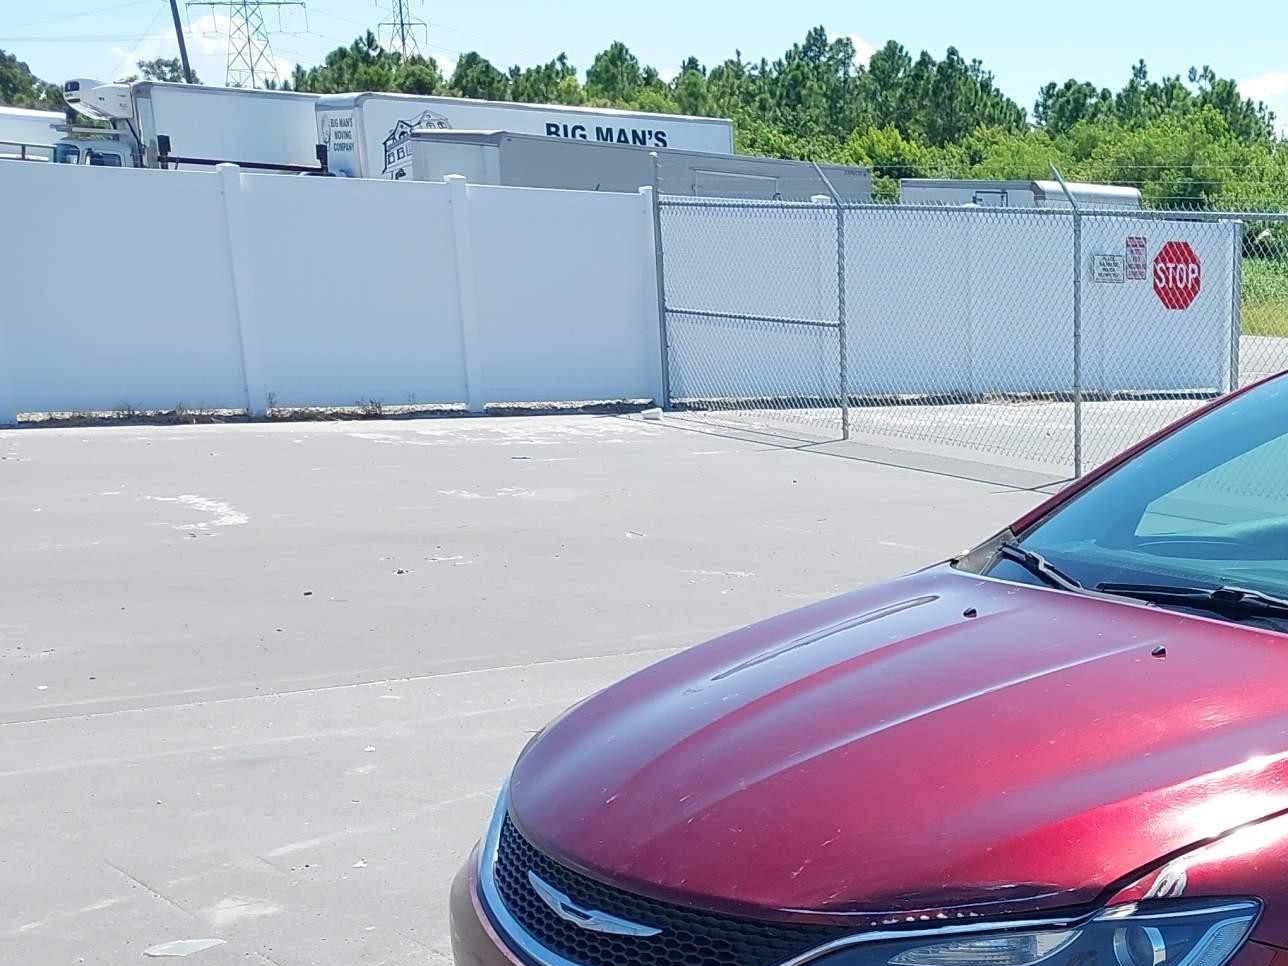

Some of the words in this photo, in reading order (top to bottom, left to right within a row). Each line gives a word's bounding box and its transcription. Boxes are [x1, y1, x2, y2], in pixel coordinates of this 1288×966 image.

[330, 118, 339, 128] BIG
[334, 130, 353, 140] MOVING
[545, 122, 587, 140] BIG
[595, 126, 668, 148] MAN'S
[333, 142, 355, 152] COMPANY
[1155, 263, 1200, 289] STOP
